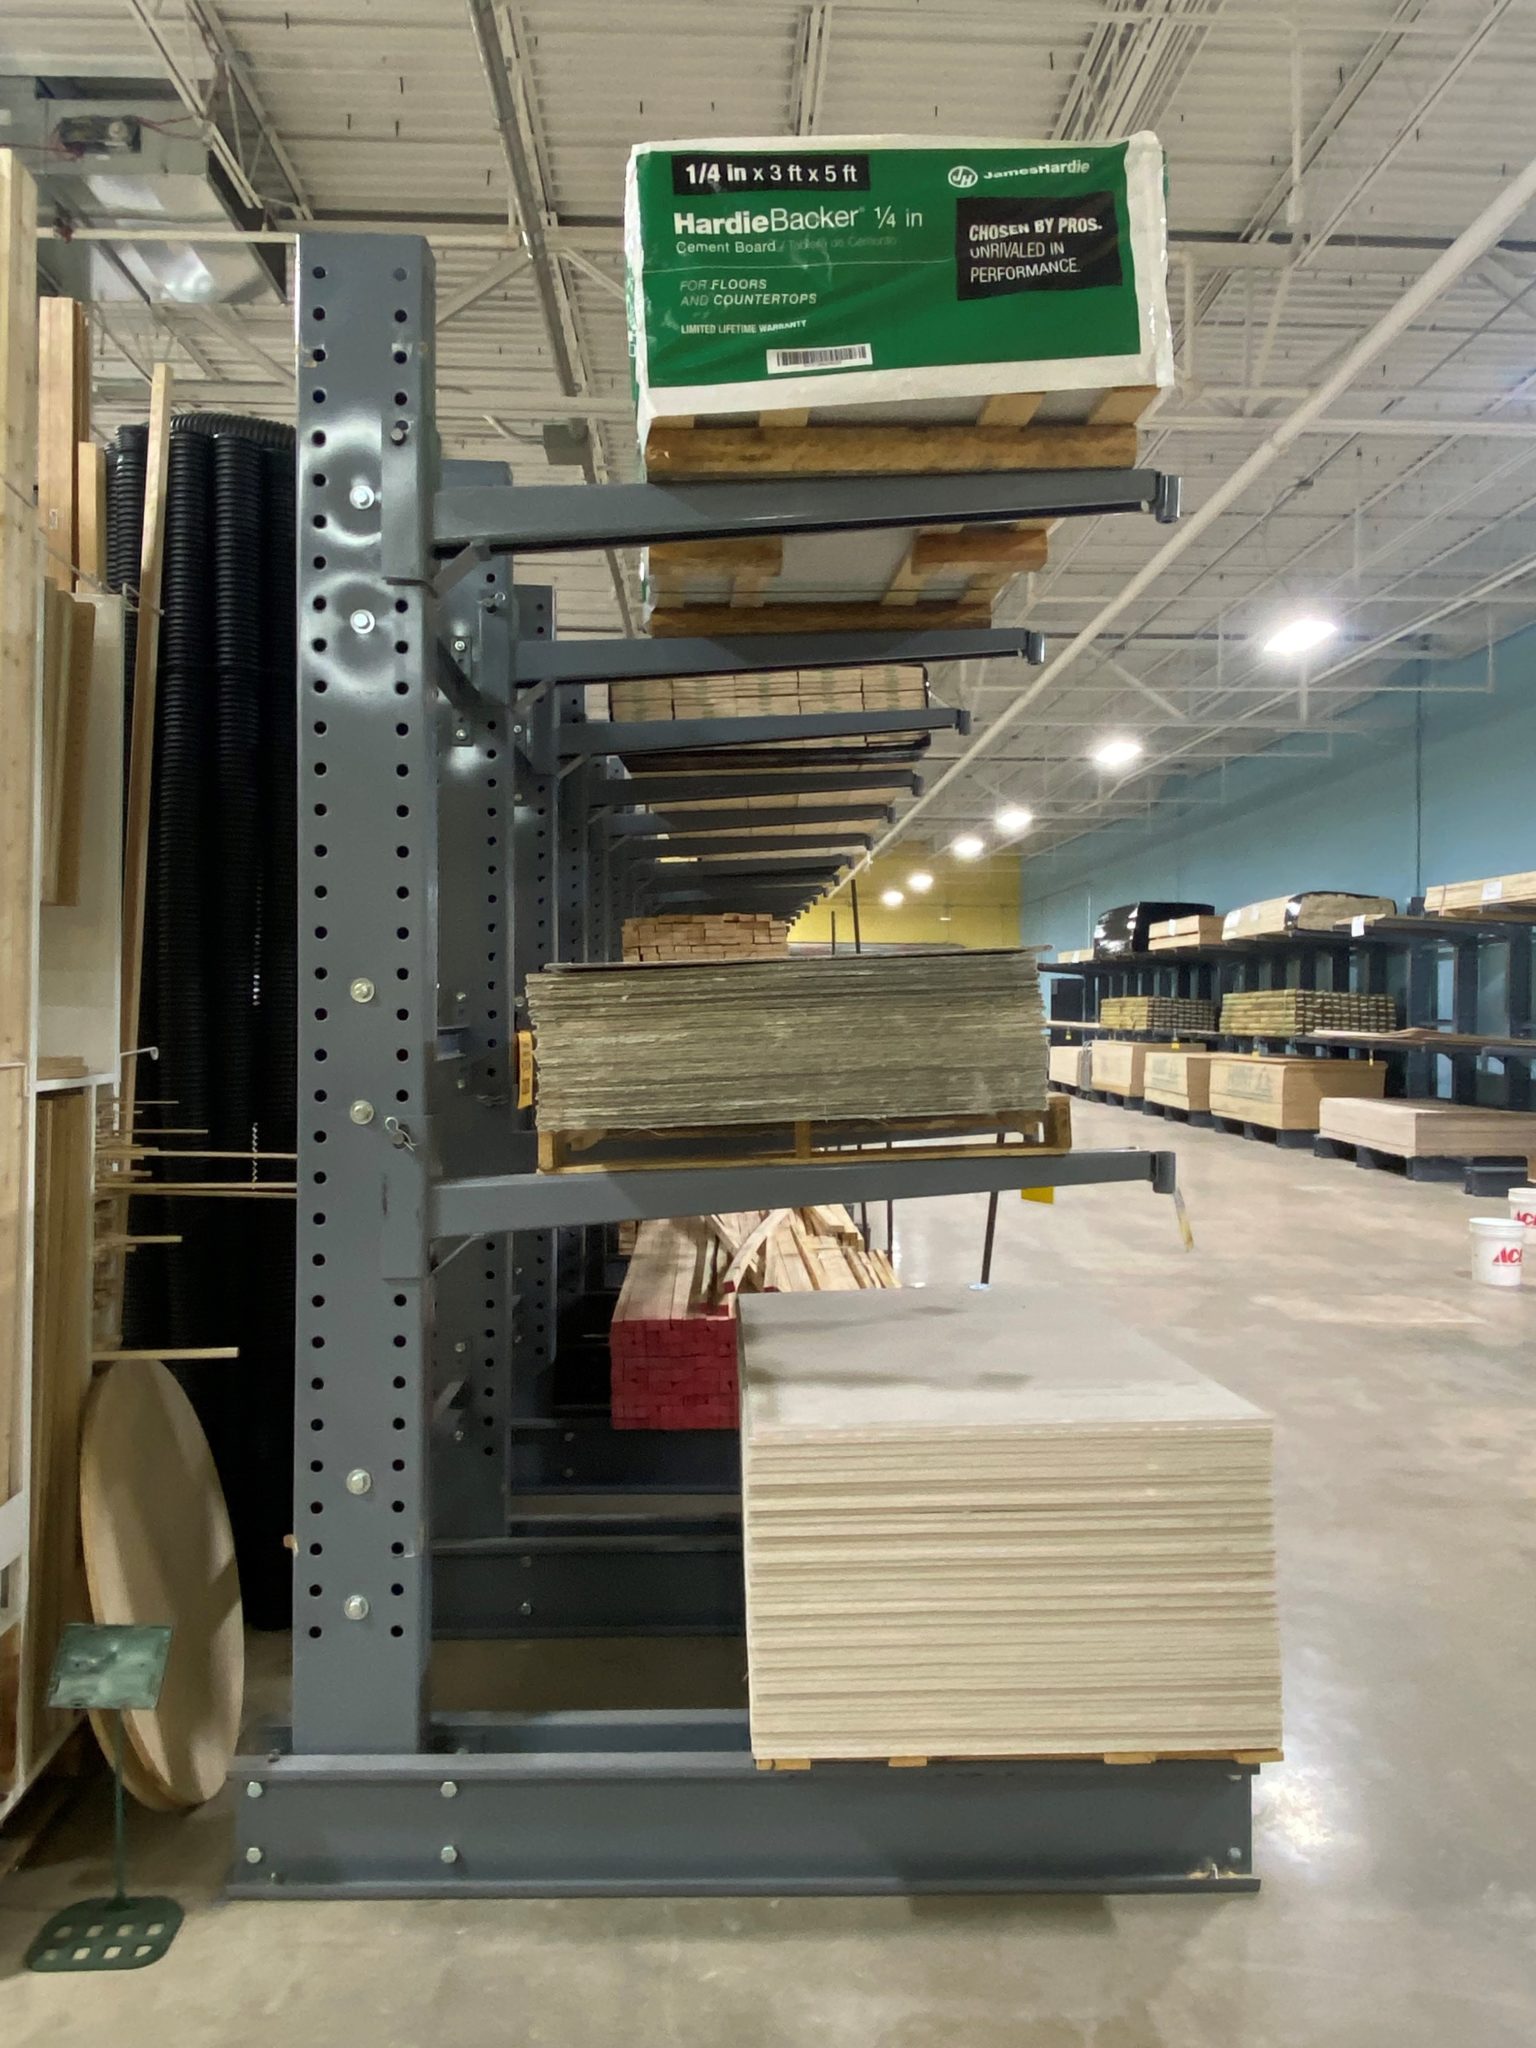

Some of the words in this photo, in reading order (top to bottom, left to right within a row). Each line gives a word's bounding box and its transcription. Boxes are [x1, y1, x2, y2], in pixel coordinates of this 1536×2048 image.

[686, 163, 720, 184] 1/4
[727, 163, 747, 182] in
[753, 167, 764, 181] x
[770, 164, 782, 181] 3
[787, 164, 802, 182] ft
[808, 168, 819, 182] x
[825, 165, 837, 182] 5
[842, 164, 858, 182] ft
[983, 160, 1091, 180] JamesHardie
[906, 208, 923, 227] in
[969, 223, 1030, 241] CHOSEN
[1034, 218, 1055, 233] BY
[1058, 217, 1103, 233] PROS.
[676, 241, 730, 254] Cement
[735, 240, 776, 254] Board
[970, 242, 1045, 258] UNRIVALED
[1050, 242, 1065, 255] IN
[680, 280, 707, 291] FOR
[711, 279, 767, 290] FLOORS
[680, 295, 709, 306] AND
[714, 293, 817, 306] COUNTERTOPS
[681, 324, 716, 334] LIMITED
[718, 323, 757, 334] LIFETIME
[759, 319, 807, 333] WARRANTY
